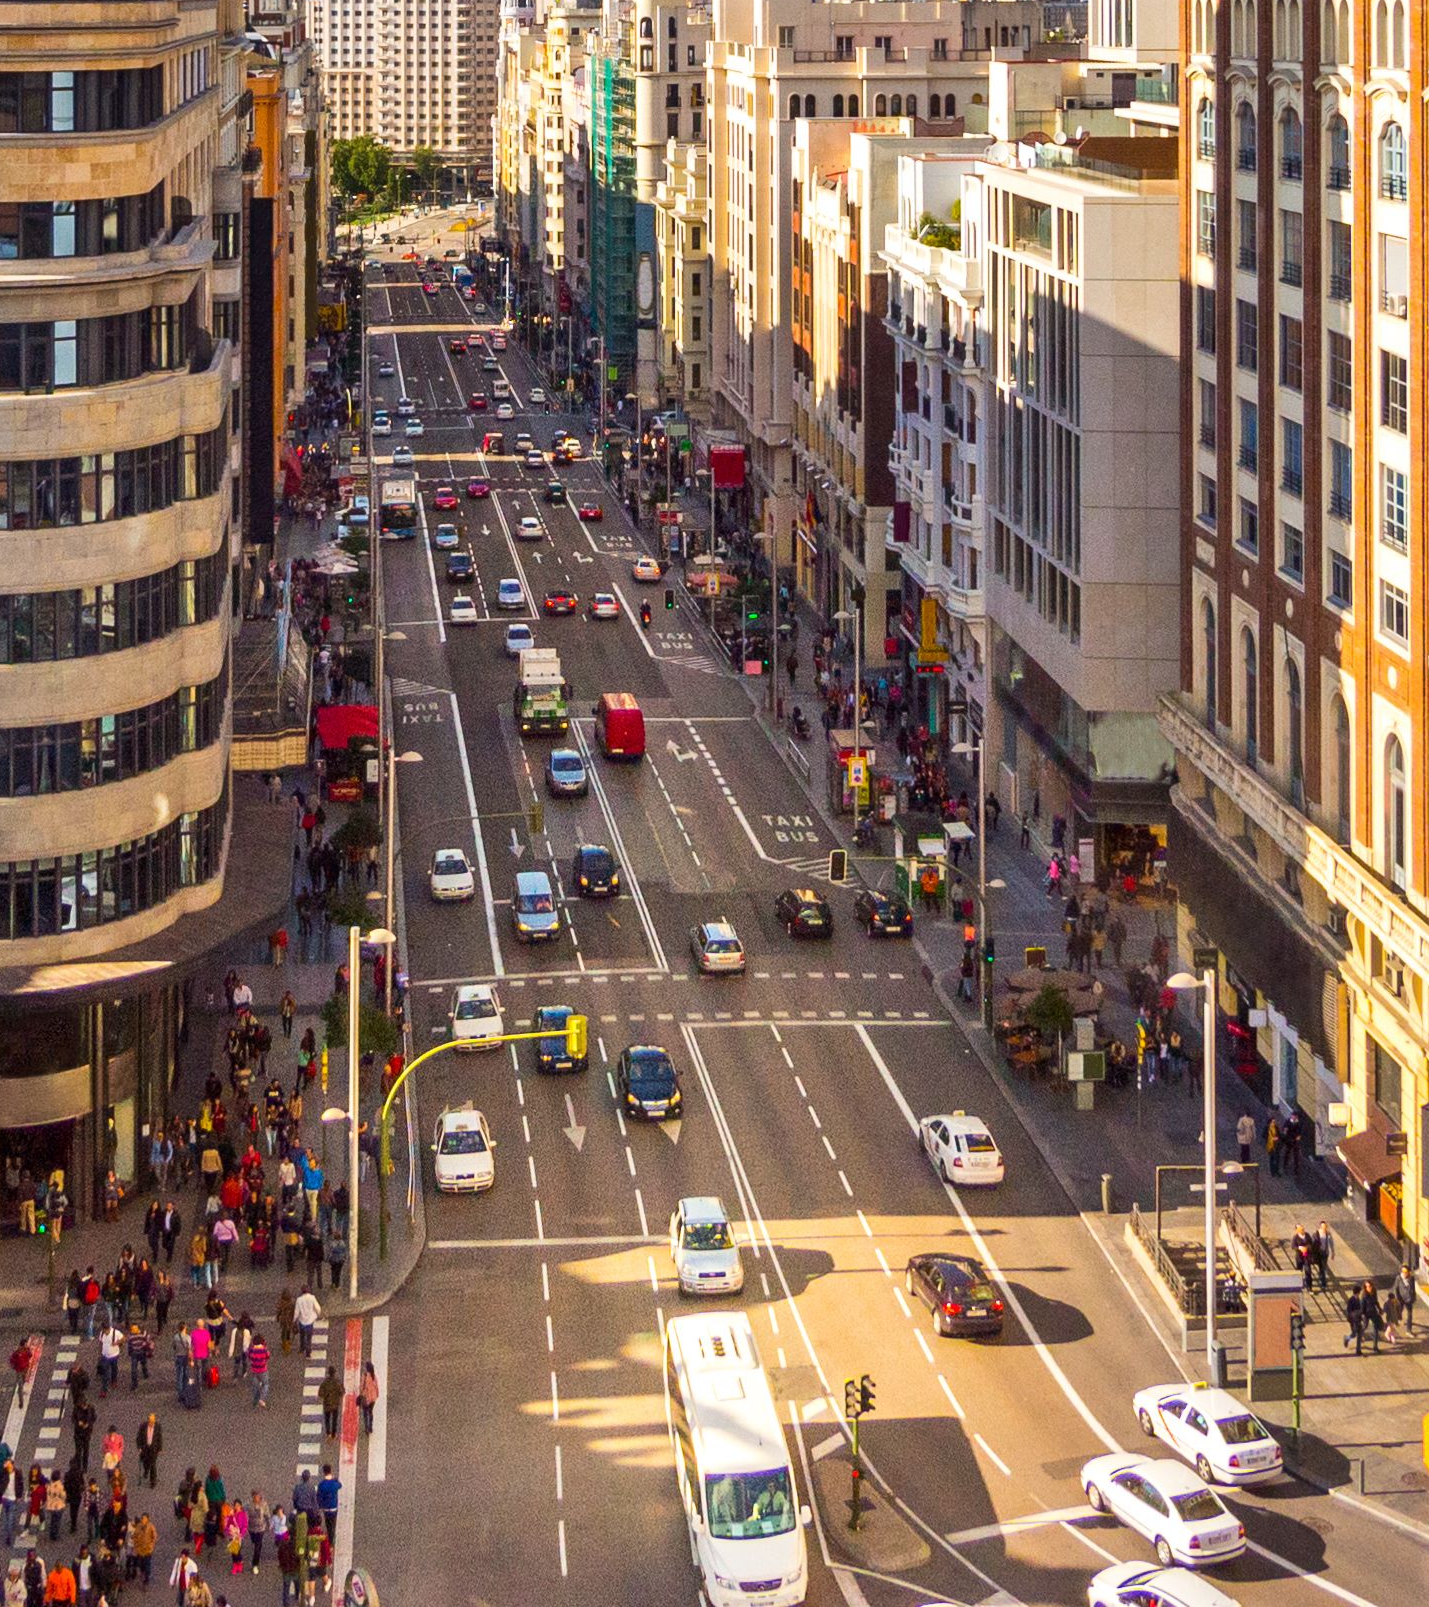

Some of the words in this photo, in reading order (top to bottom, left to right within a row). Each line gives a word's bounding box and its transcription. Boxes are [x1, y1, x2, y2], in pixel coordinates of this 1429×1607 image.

[655, 632, 693, 640] TAXI
[403, 702, 439, 712] BUS
[402, 713, 445, 724] TAXI
[761, 814, 814, 827] TAXI
[774, 831, 820, 843] BUS
